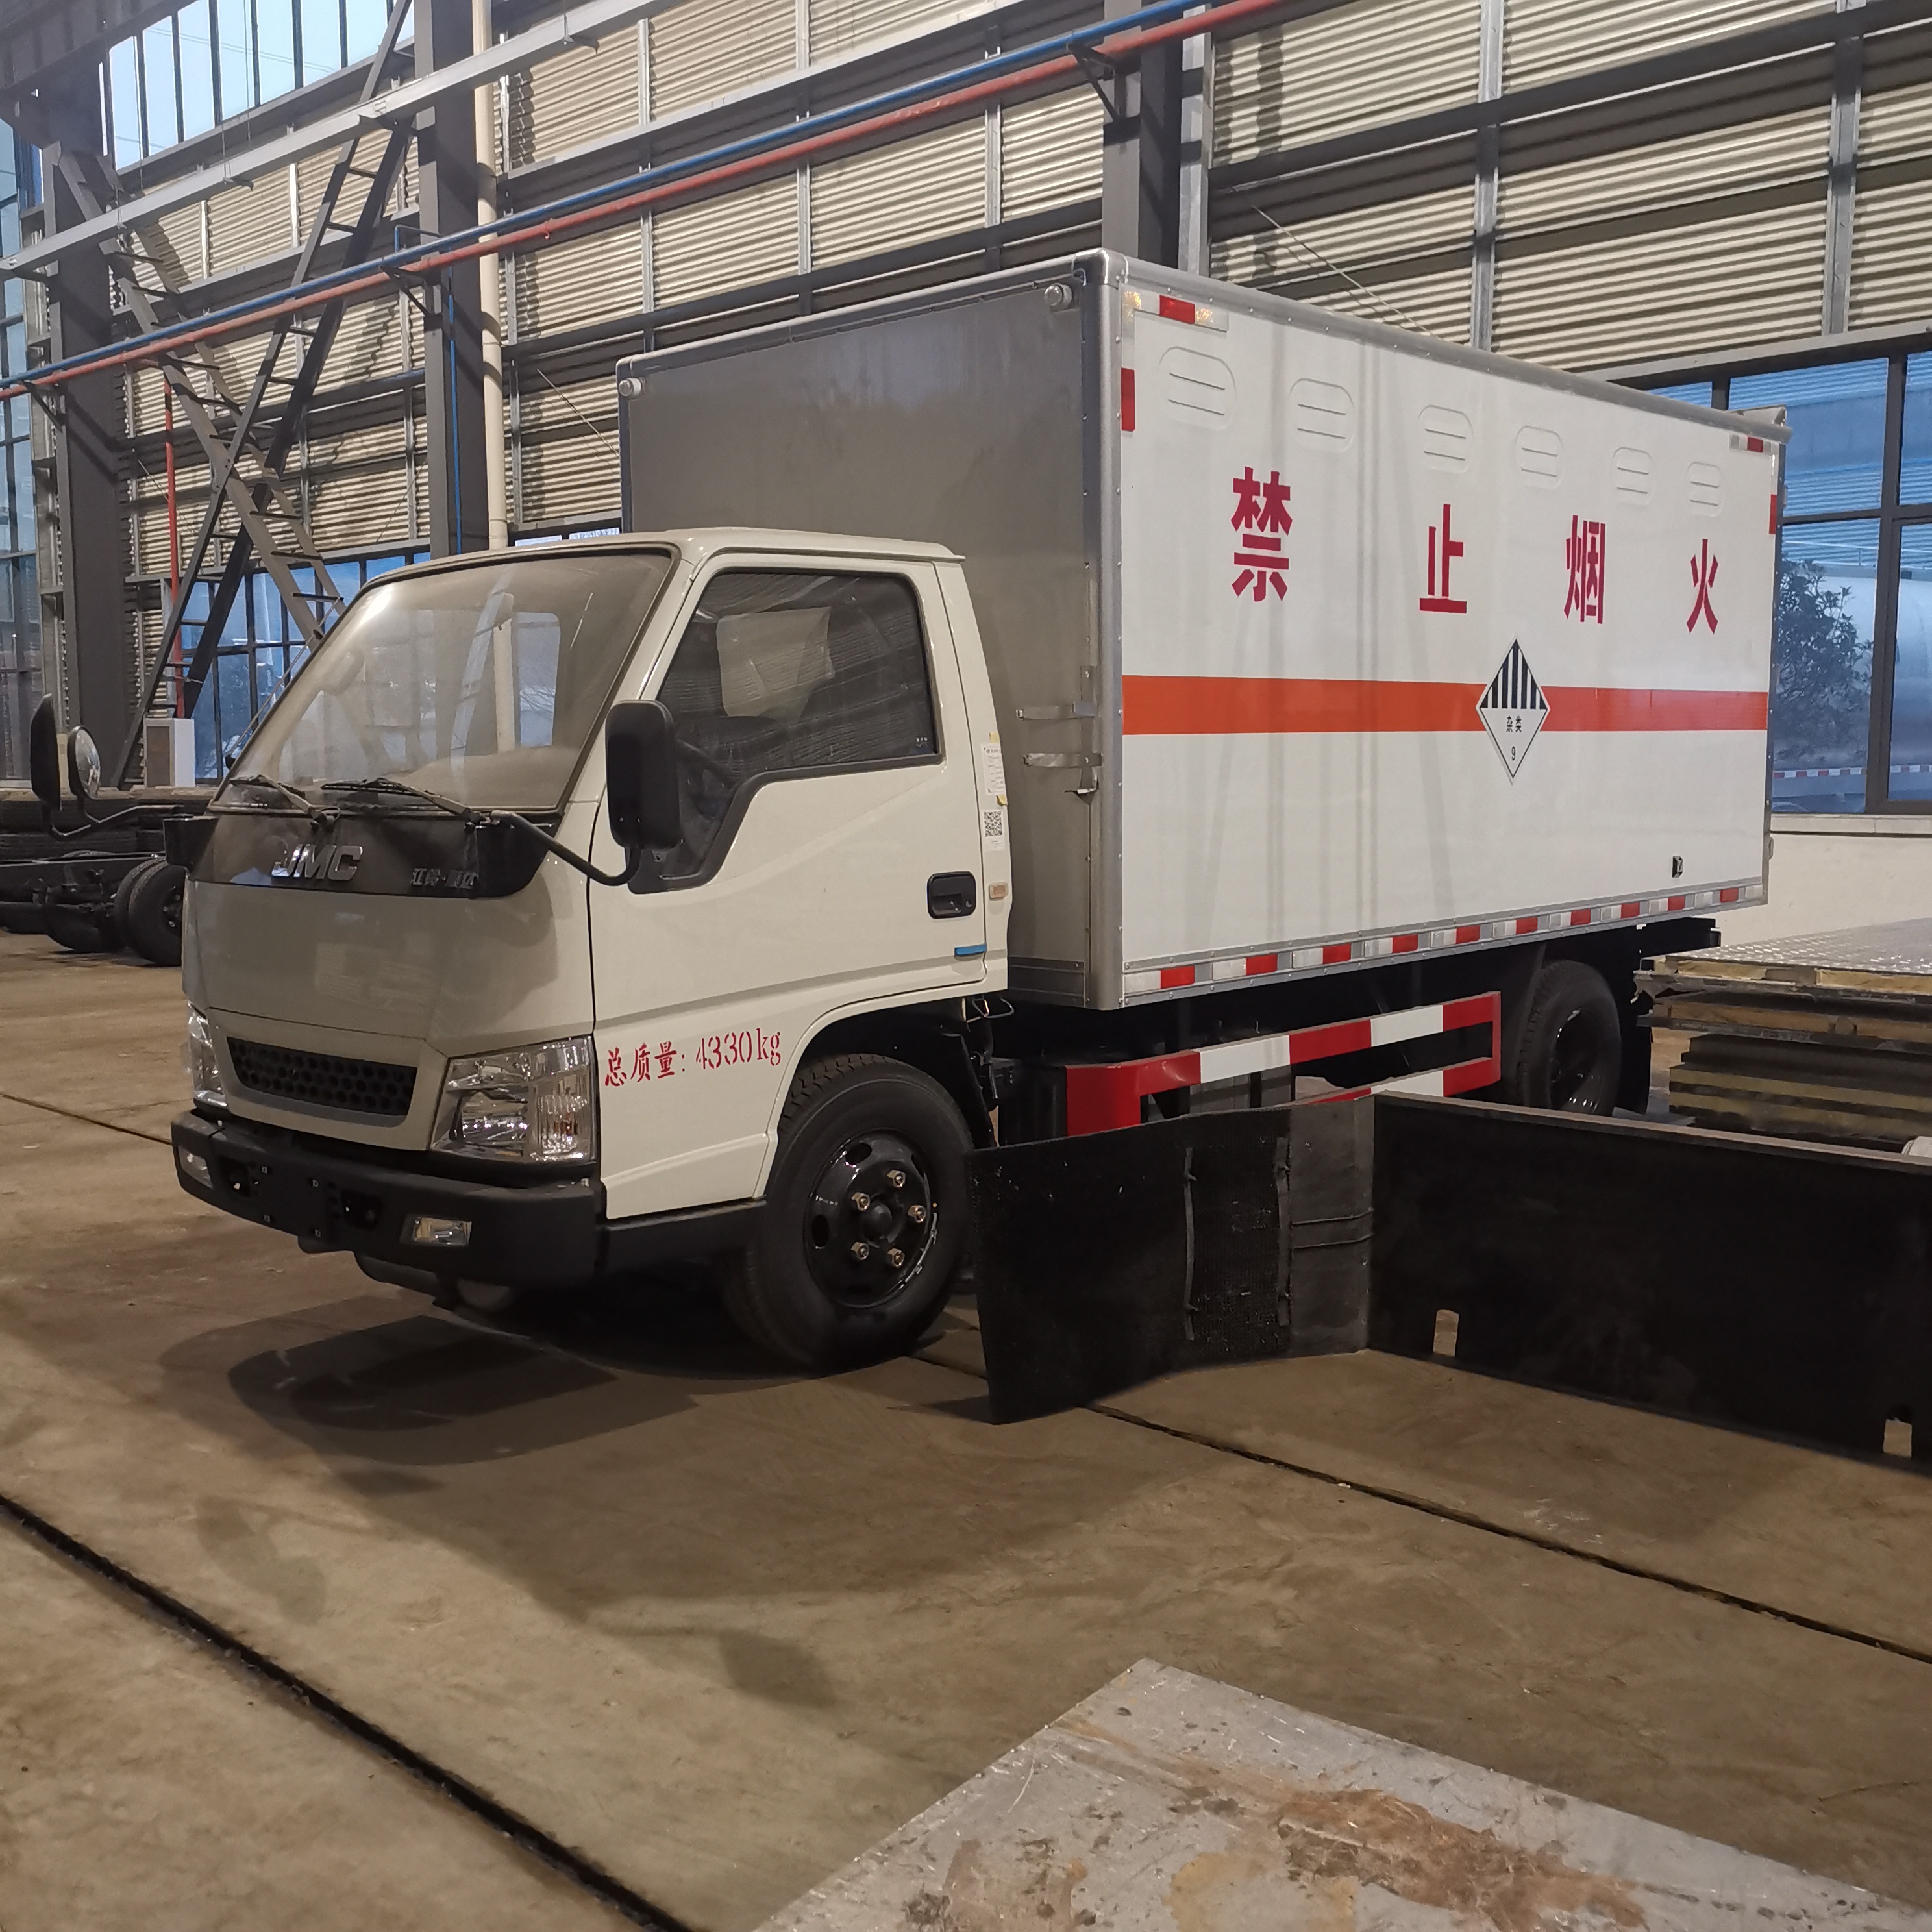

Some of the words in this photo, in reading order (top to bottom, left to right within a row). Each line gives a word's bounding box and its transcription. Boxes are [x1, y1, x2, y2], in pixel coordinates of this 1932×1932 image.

[1231, 465, 1718, 634] 禁止烟火
[1506, 715, 1522, 732] 杂类
[1511, 746, 1516, 761] 9
[271, 843, 364, 881] JMC
